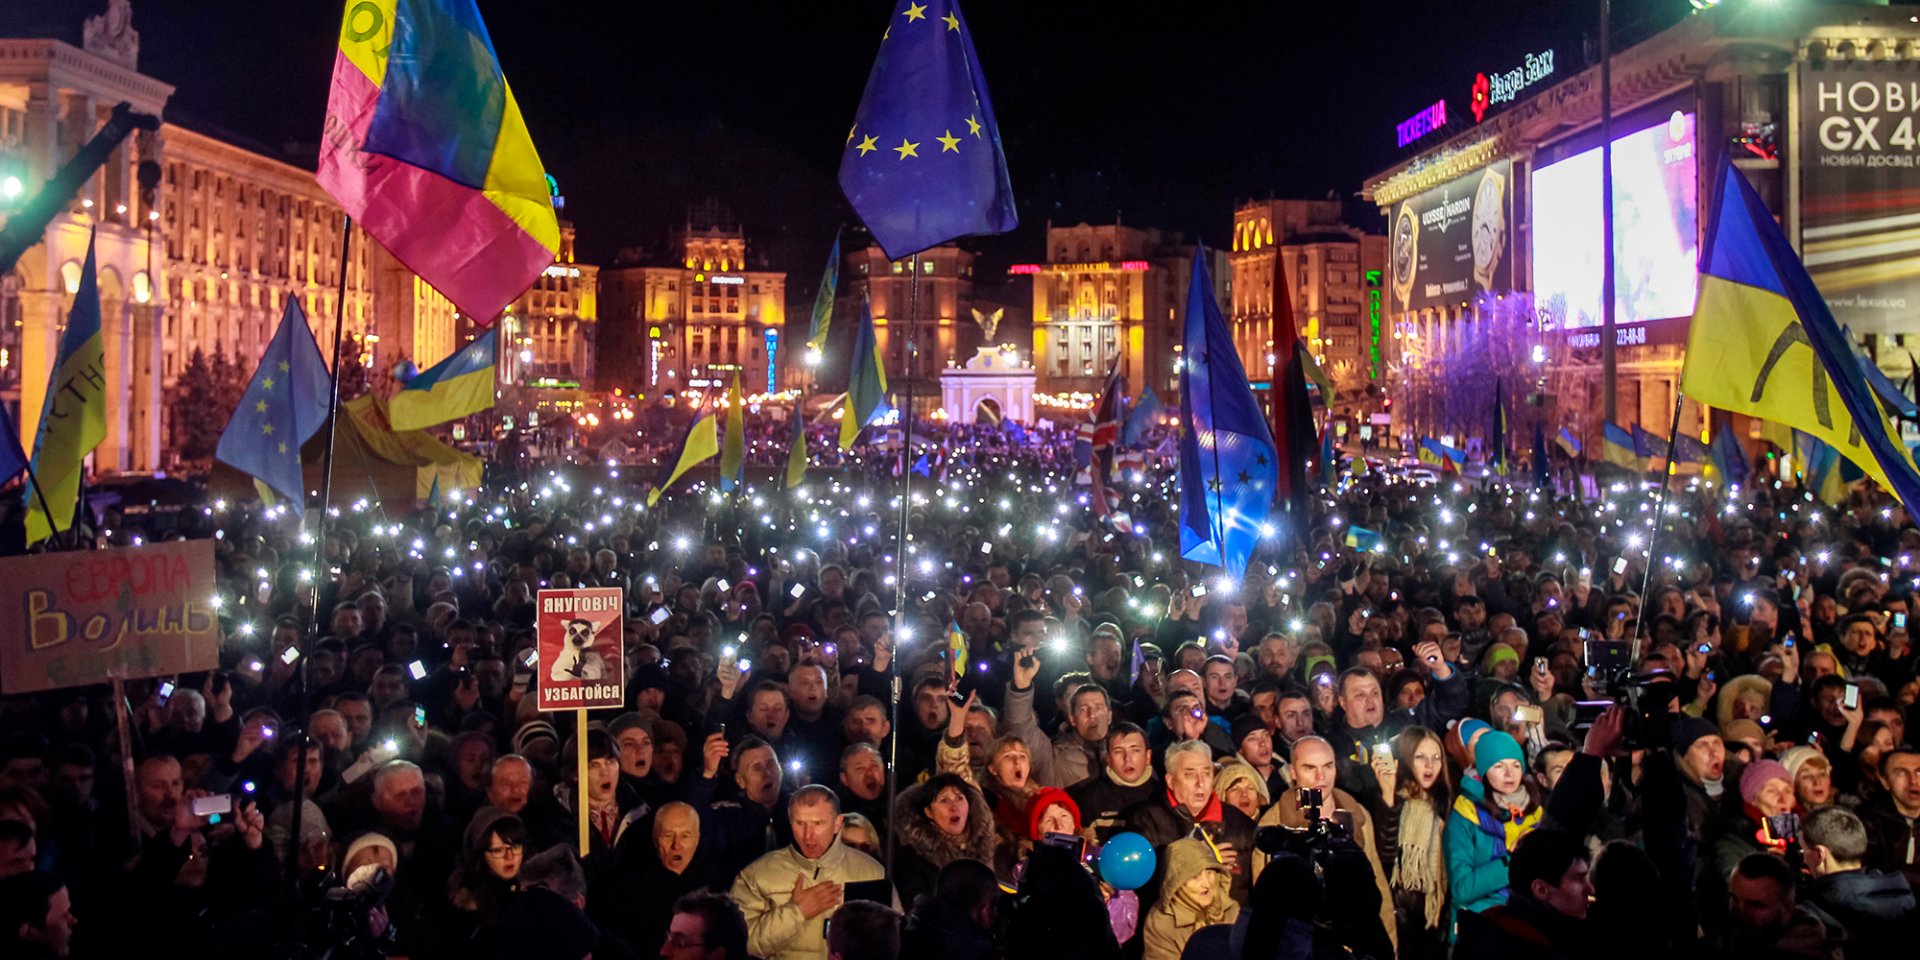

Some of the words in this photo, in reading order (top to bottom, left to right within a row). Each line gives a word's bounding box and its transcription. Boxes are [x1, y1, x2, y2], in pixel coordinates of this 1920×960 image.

[1818, 115, 1881, 151] GX
[1888, 116, 1920, 151] 4
[1820, 152, 1865, 167] НОВИЙ
[1867, 154, 1914, 168] ДОСВІД
[1422, 207, 1444, 226] ULYSSE
[1446, 197, 1470, 218] NARDIN
[65, 553, 191, 604] ЄВРОПА
[543, 596, 618, 613] ЯНУГОВІЧ
[24, 588, 215, 653] Волинь
[544, 683, 620, 701] УЗБАГОЙСЯ
